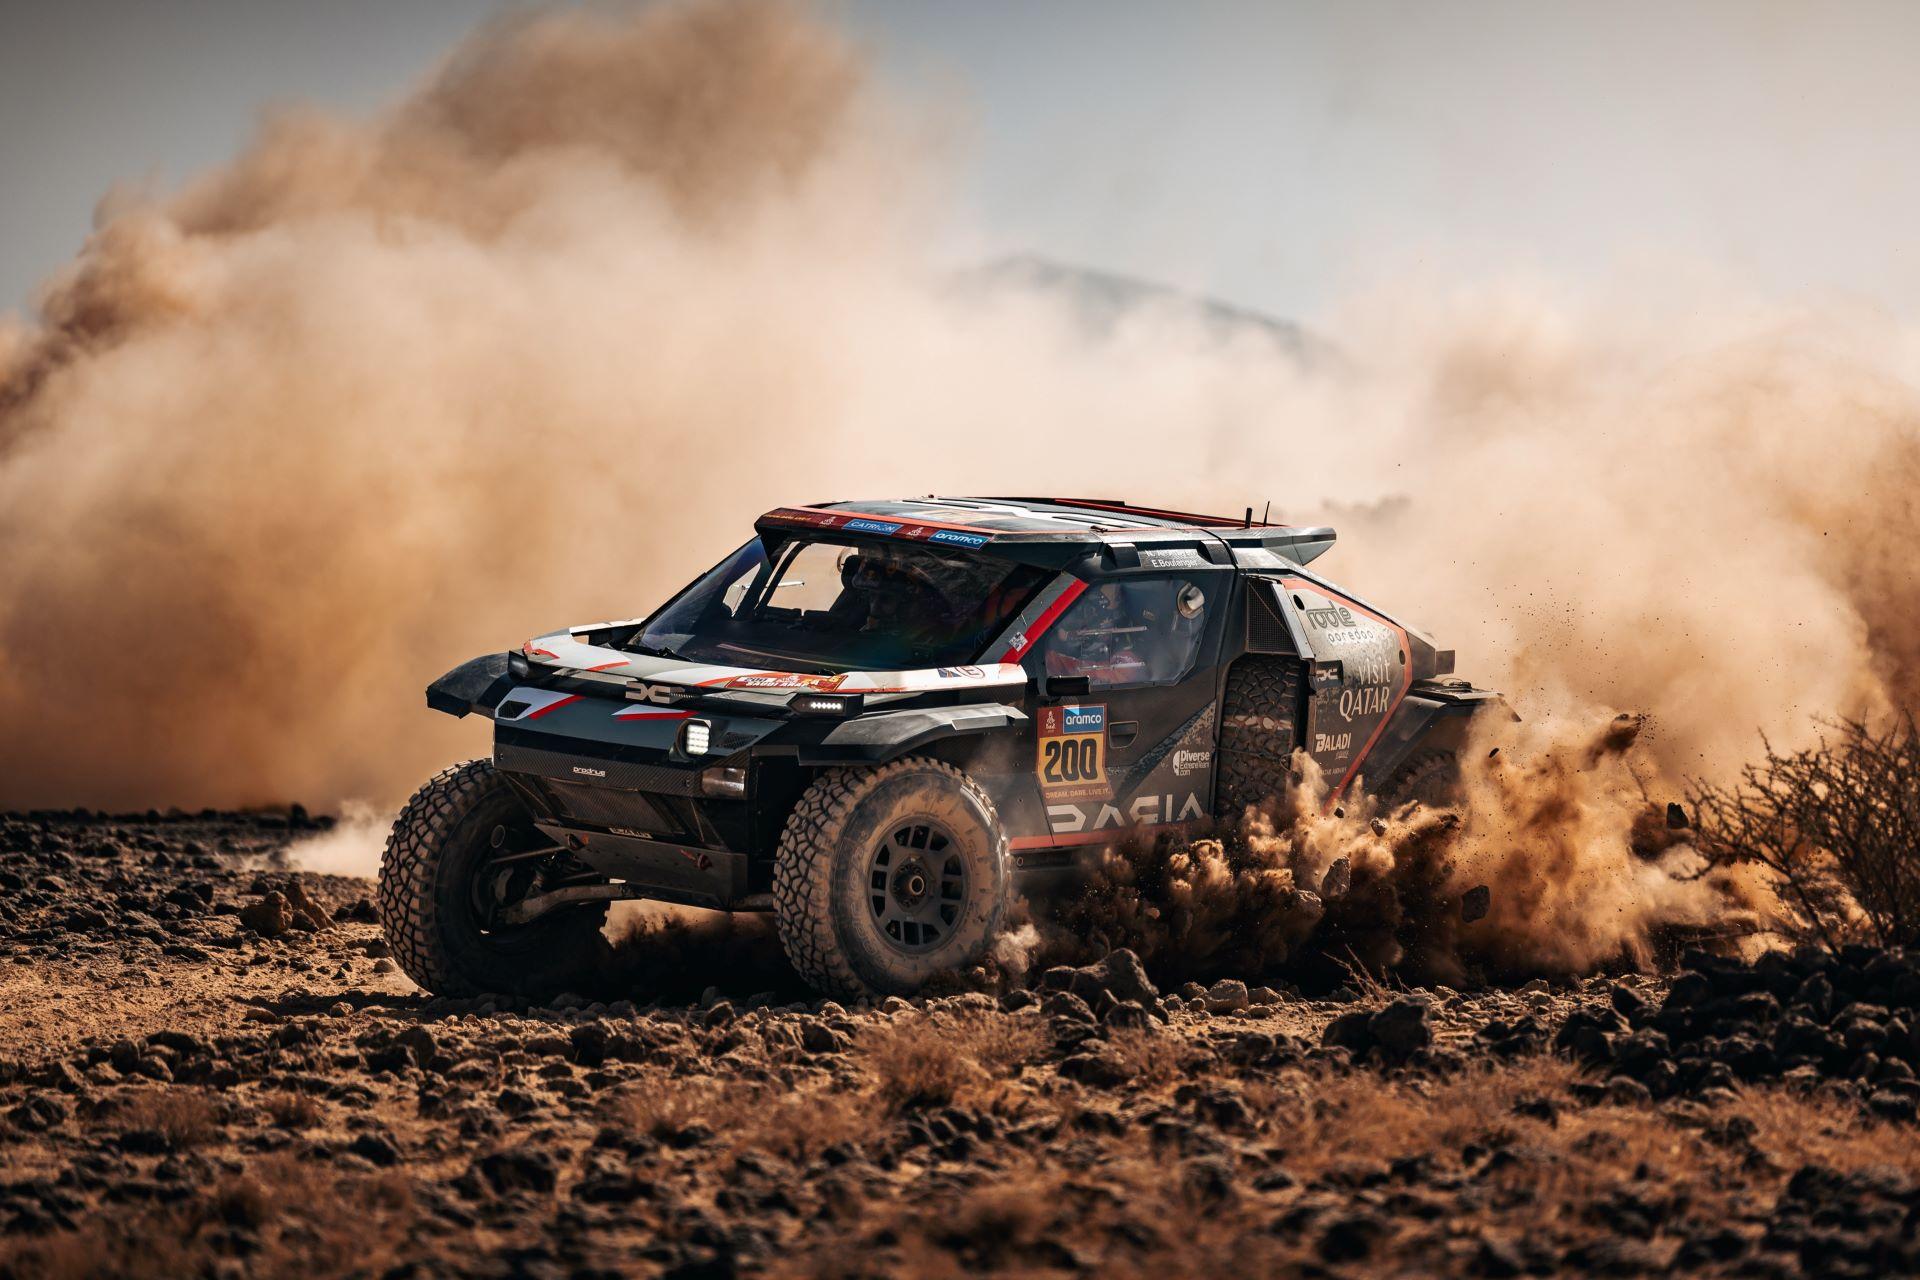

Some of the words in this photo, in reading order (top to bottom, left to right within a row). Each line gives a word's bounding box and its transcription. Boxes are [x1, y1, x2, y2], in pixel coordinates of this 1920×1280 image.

[935, 532, 983, 545] aramco
[1328, 629, 1374, 643] ooredoo
[1339, 686, 1390, 722] QATAR
[1065, 713, 1102, 725] aramco
[1315, 732, 1352, 753] BALADI
[1044, 738, 1099, 783] 200
[1180, 750, 1210, 761] Diverse
[1047, 792, 1204, 832] DACIA
